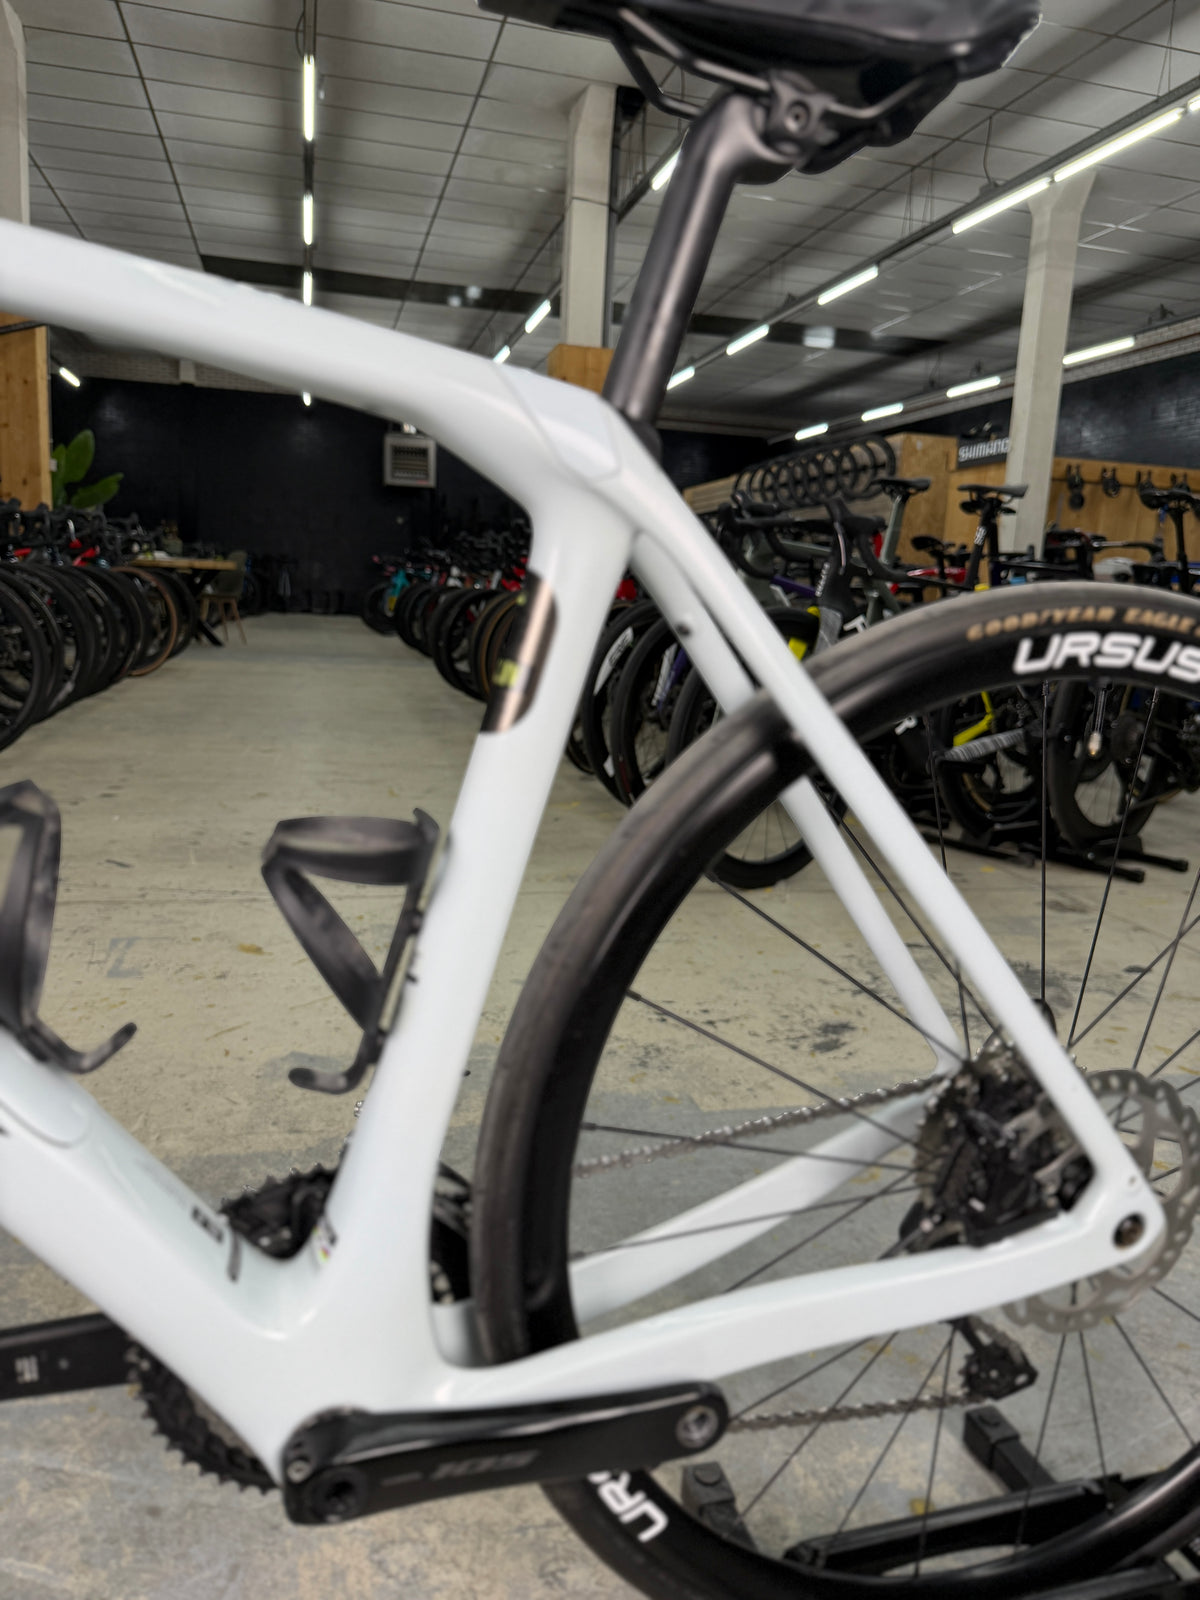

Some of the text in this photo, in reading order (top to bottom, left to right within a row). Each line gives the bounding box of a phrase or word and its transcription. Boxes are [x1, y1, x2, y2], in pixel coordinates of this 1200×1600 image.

[1123, 606, 1196, 634] EAGLE
[1013, 630, 1200, 683] URSUS
[587, 1471, 669, 1543] UR
